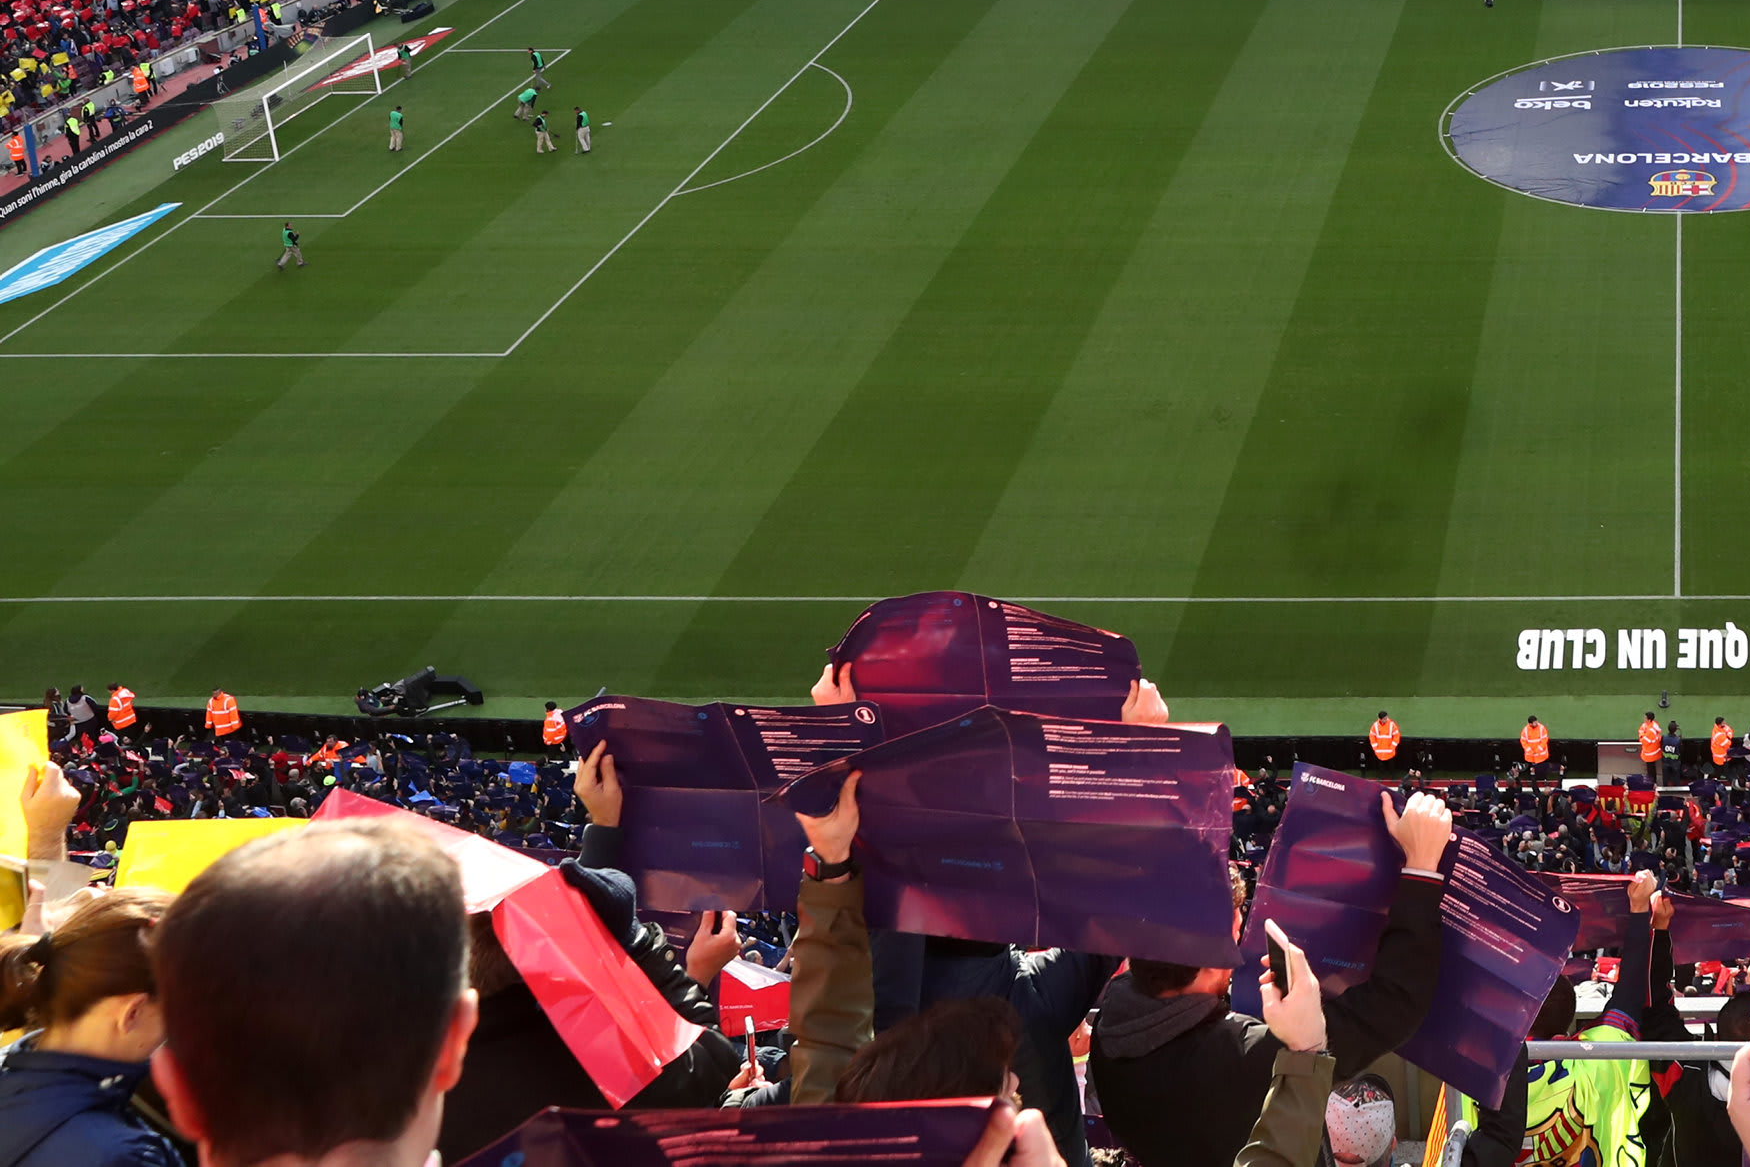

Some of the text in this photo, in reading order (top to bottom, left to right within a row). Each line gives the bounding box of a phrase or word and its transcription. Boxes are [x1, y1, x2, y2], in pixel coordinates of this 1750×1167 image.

[1514, 98, 1592, 110] beko
[1624, 98, 1721, 109] Rakuten
[18, 190, 33, 207] soni
[60, 170, 72, 184] gira
[72, 165, 79, 175] la
[78, 151, 105, 170] cartolina
[108, 137, 128, 152] mostra
[128, 131, 135, 140] la
[135, 124, 148, 136] cara
[147, 120, 153, 130] 2
[173, 131, 225, 171] PES2019
[1573, 153, 1750, 164] BARCELONA
[1516, 628, 1606, 670] CLUB
[1617, 628, 1667, 669] UN
[1676, 621, 1749, 669] QUE
[1316, 777, 1345, 792] BARCELONA
